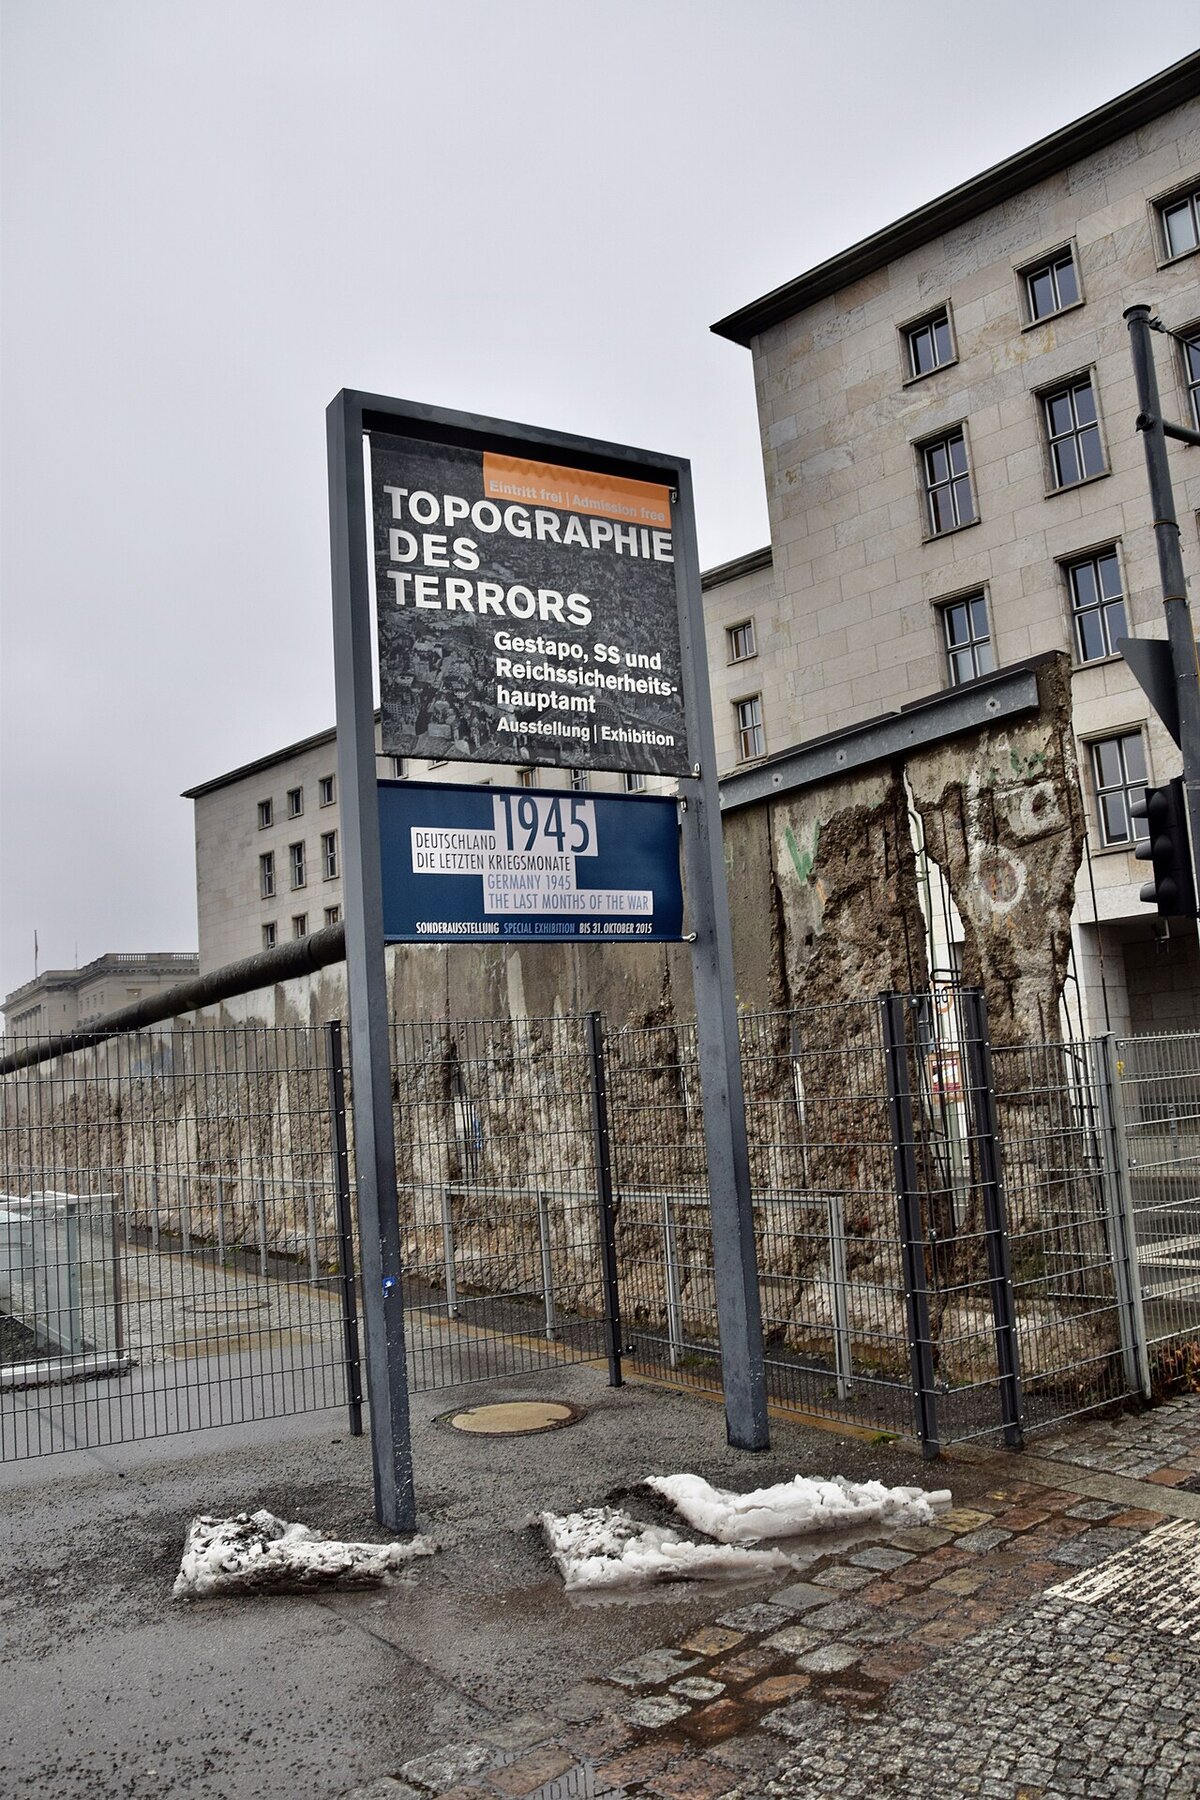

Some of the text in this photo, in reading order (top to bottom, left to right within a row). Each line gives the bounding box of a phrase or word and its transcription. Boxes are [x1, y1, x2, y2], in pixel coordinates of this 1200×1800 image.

[489, 479, 536, 498] Eintritt
[540, 488, 562, 504] frei
[573, 495, 637, 517] Admission
[640, 507, 665, 522] free
[383, 485, 675, 563] TOPOGRAPHIE
[389, 528, 480, 571] DES
[387, 570, 593, 626] TERRORS
[494, 631, 662, 671] Gestapo, SS und
[496, 657, 678, 697] Reichssicherheits-
[497, 685, 596, 713] hauptamt
[497, 716, 590, 741] Ausstellung
[601, 726, 675, 746] Exhibition
[416, 832, 496, 850] DEUTSCHLAND
[500, 794, 590, 853] 1945
[417, 852, 571, 871] DIE LETZTEN KRIEGSMONATE
[487, 873, 571, 890] GERMANY 1945
[488, 893, 649, 911] THE LAST MONTHS OF THE WAR
[416, 921, 500, 934] SONDERAUSSTELLUNG
[503, 922, 533, 934] SPECIAL
[534, 922, 575, 934] EXHIBITION
[579, 922, 591, 934] BIS
[635, 922, 653, 934] 2015
